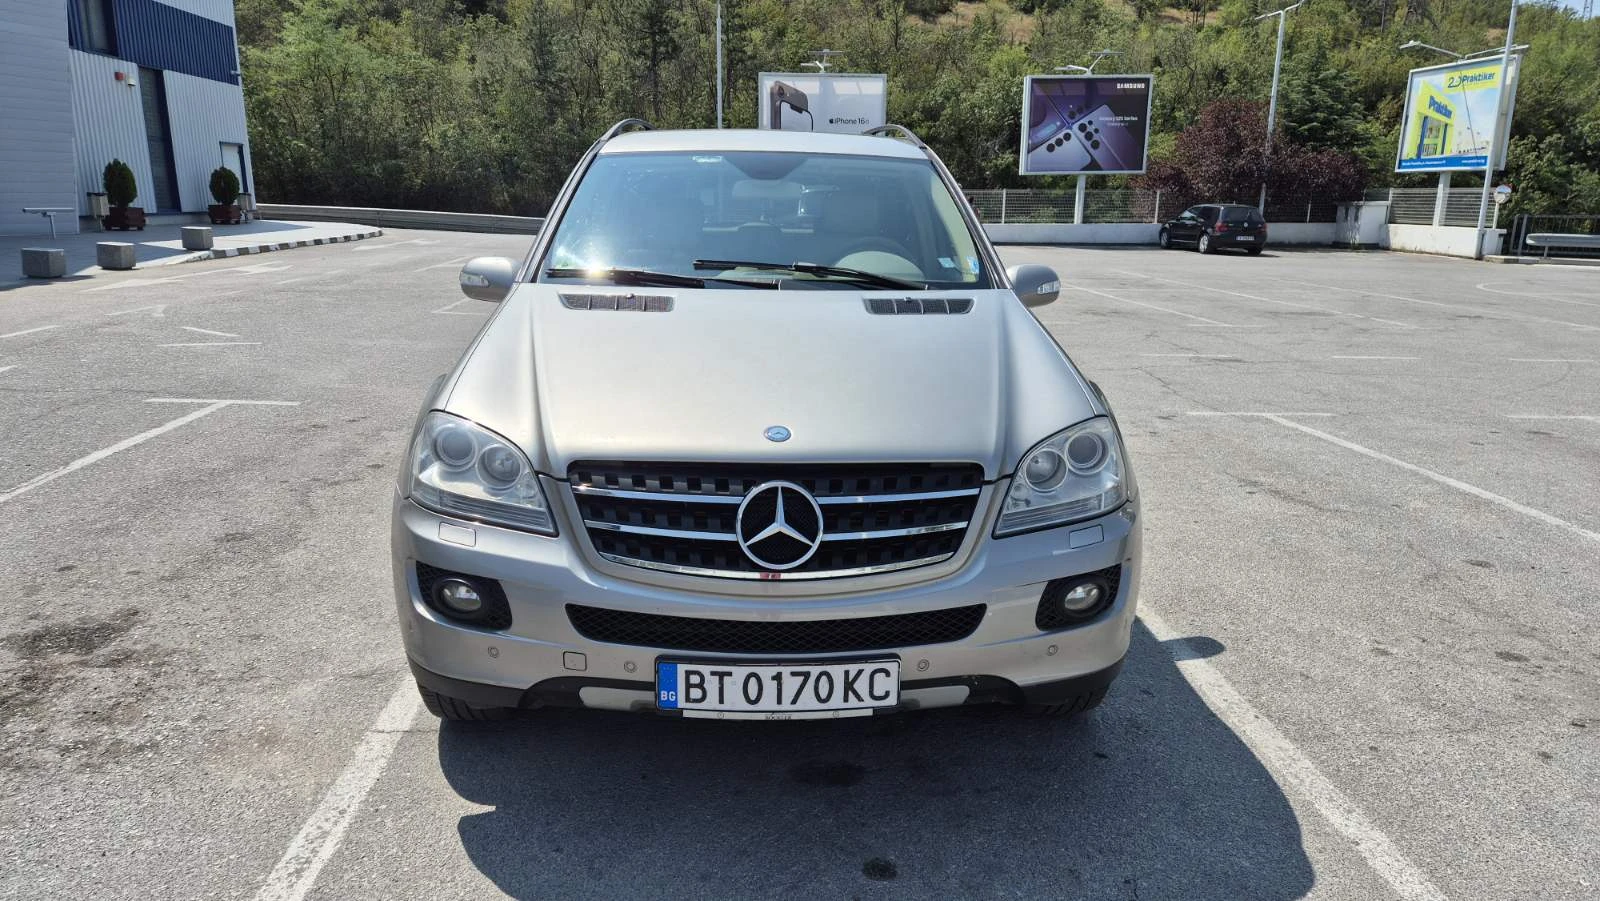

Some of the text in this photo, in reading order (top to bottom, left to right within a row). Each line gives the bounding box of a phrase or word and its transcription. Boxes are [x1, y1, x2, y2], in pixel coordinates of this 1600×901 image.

[1462, 72, 1496, 84] Praktiker
[834, 117, 858, 125] iPhone
[684, 668, 891, 705] BT 0170 KC
[660, 690, 676, 702] BG
